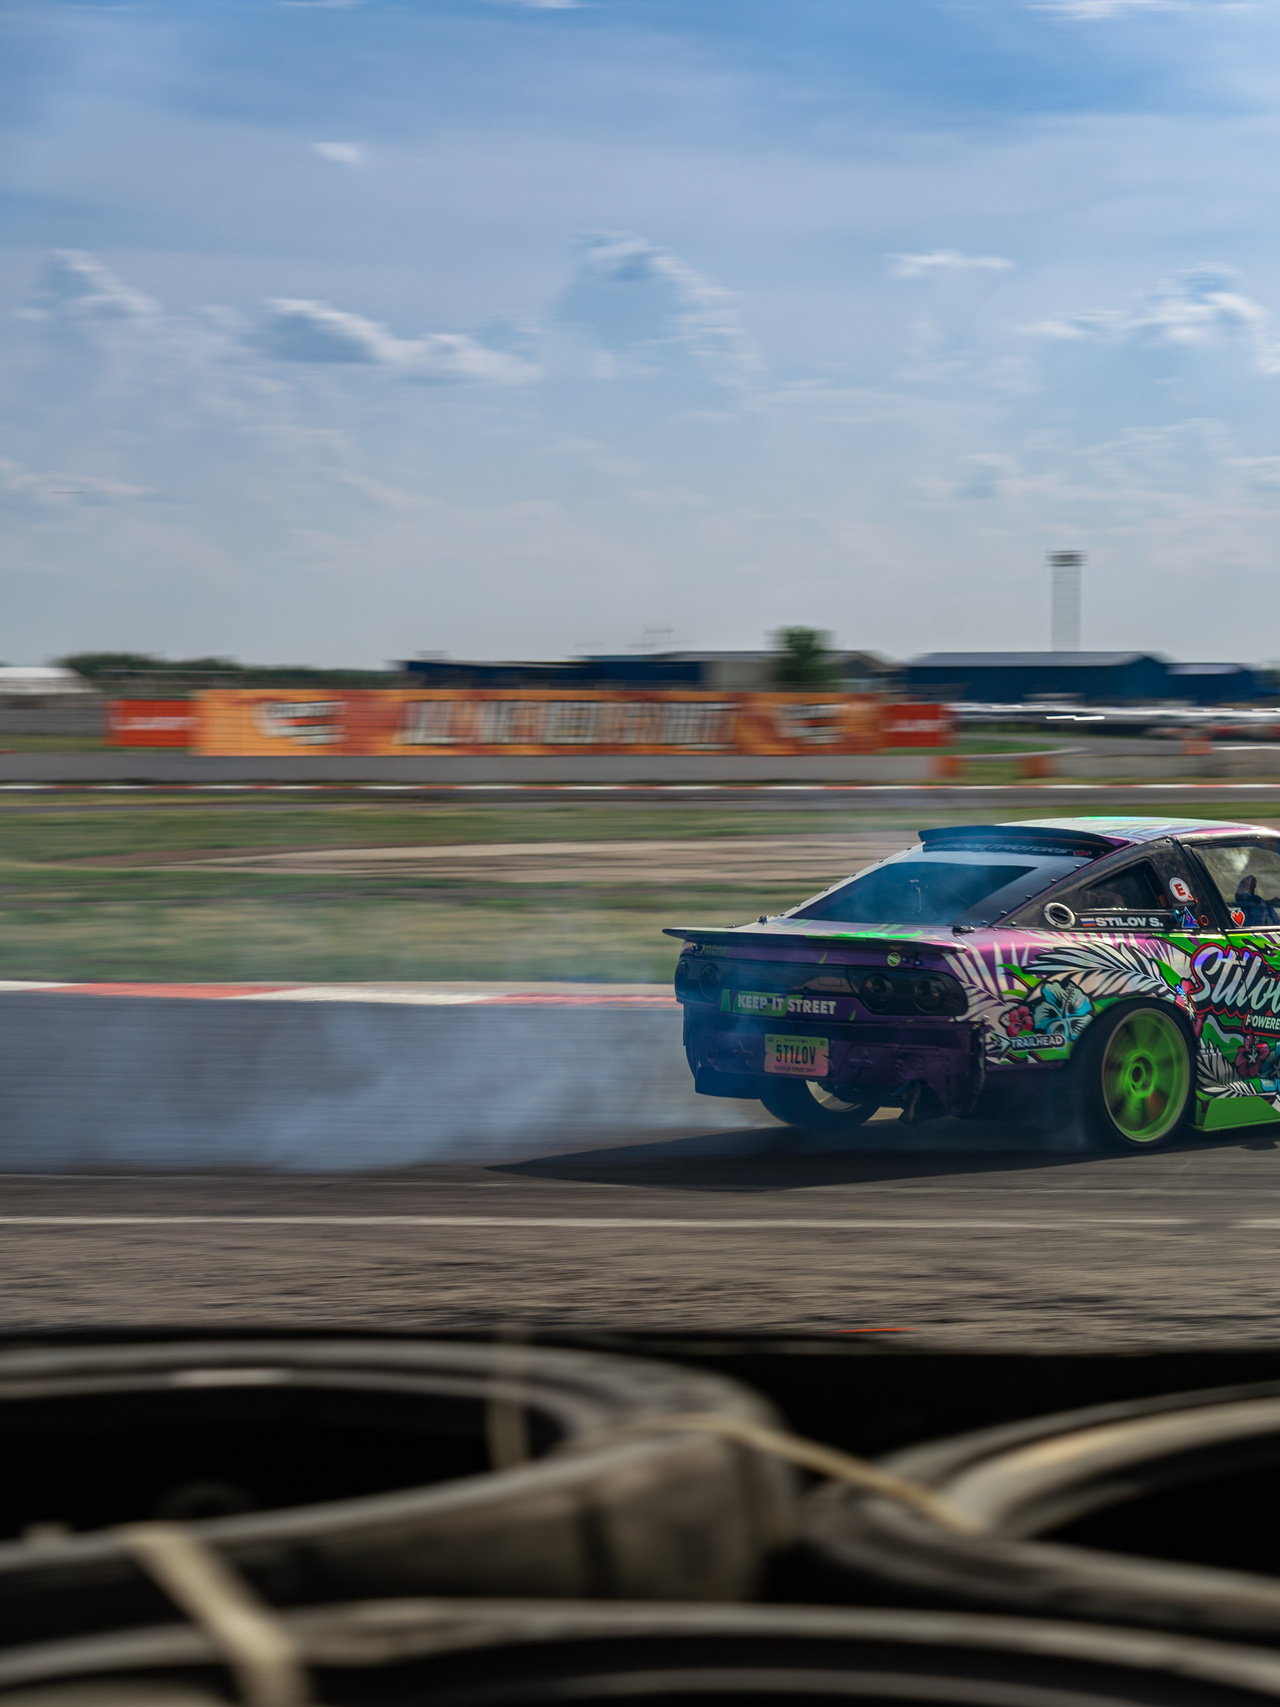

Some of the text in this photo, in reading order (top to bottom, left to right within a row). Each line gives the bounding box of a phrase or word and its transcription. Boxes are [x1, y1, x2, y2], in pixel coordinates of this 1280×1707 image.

[1095, 917, 1164, 927] STILOV S.
[737, 994, 837, 1015] KEEP IT STREET
[1011, 1035, 1064, 1049] TRAILHEAD
